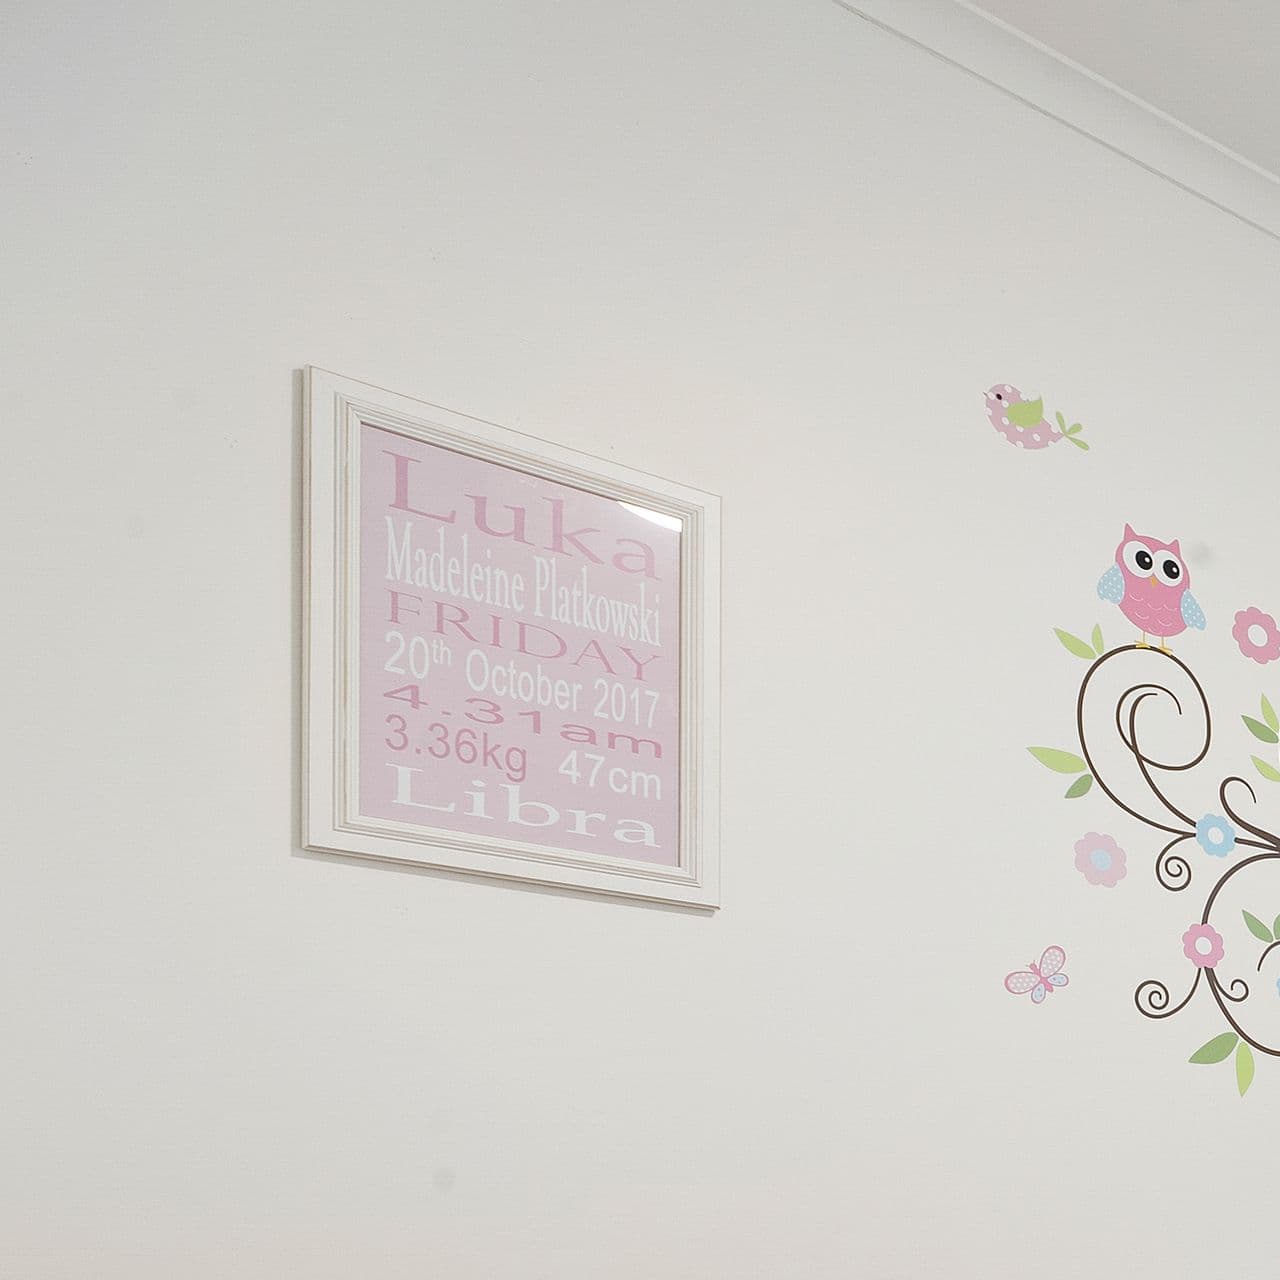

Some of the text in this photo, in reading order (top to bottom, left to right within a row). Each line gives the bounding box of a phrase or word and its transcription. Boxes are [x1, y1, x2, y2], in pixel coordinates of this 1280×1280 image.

[382, 449, 662, 581] Luka
[384, 515, 662, 647] Madeleine Platkowski
[383, 630, 660, 729] 20th October 2017
[384, 588, 664, 682] FRIDAY
[385, 713, 662, 801] 3.36kg 47cm
[385, 762, 662, 848] Libra
